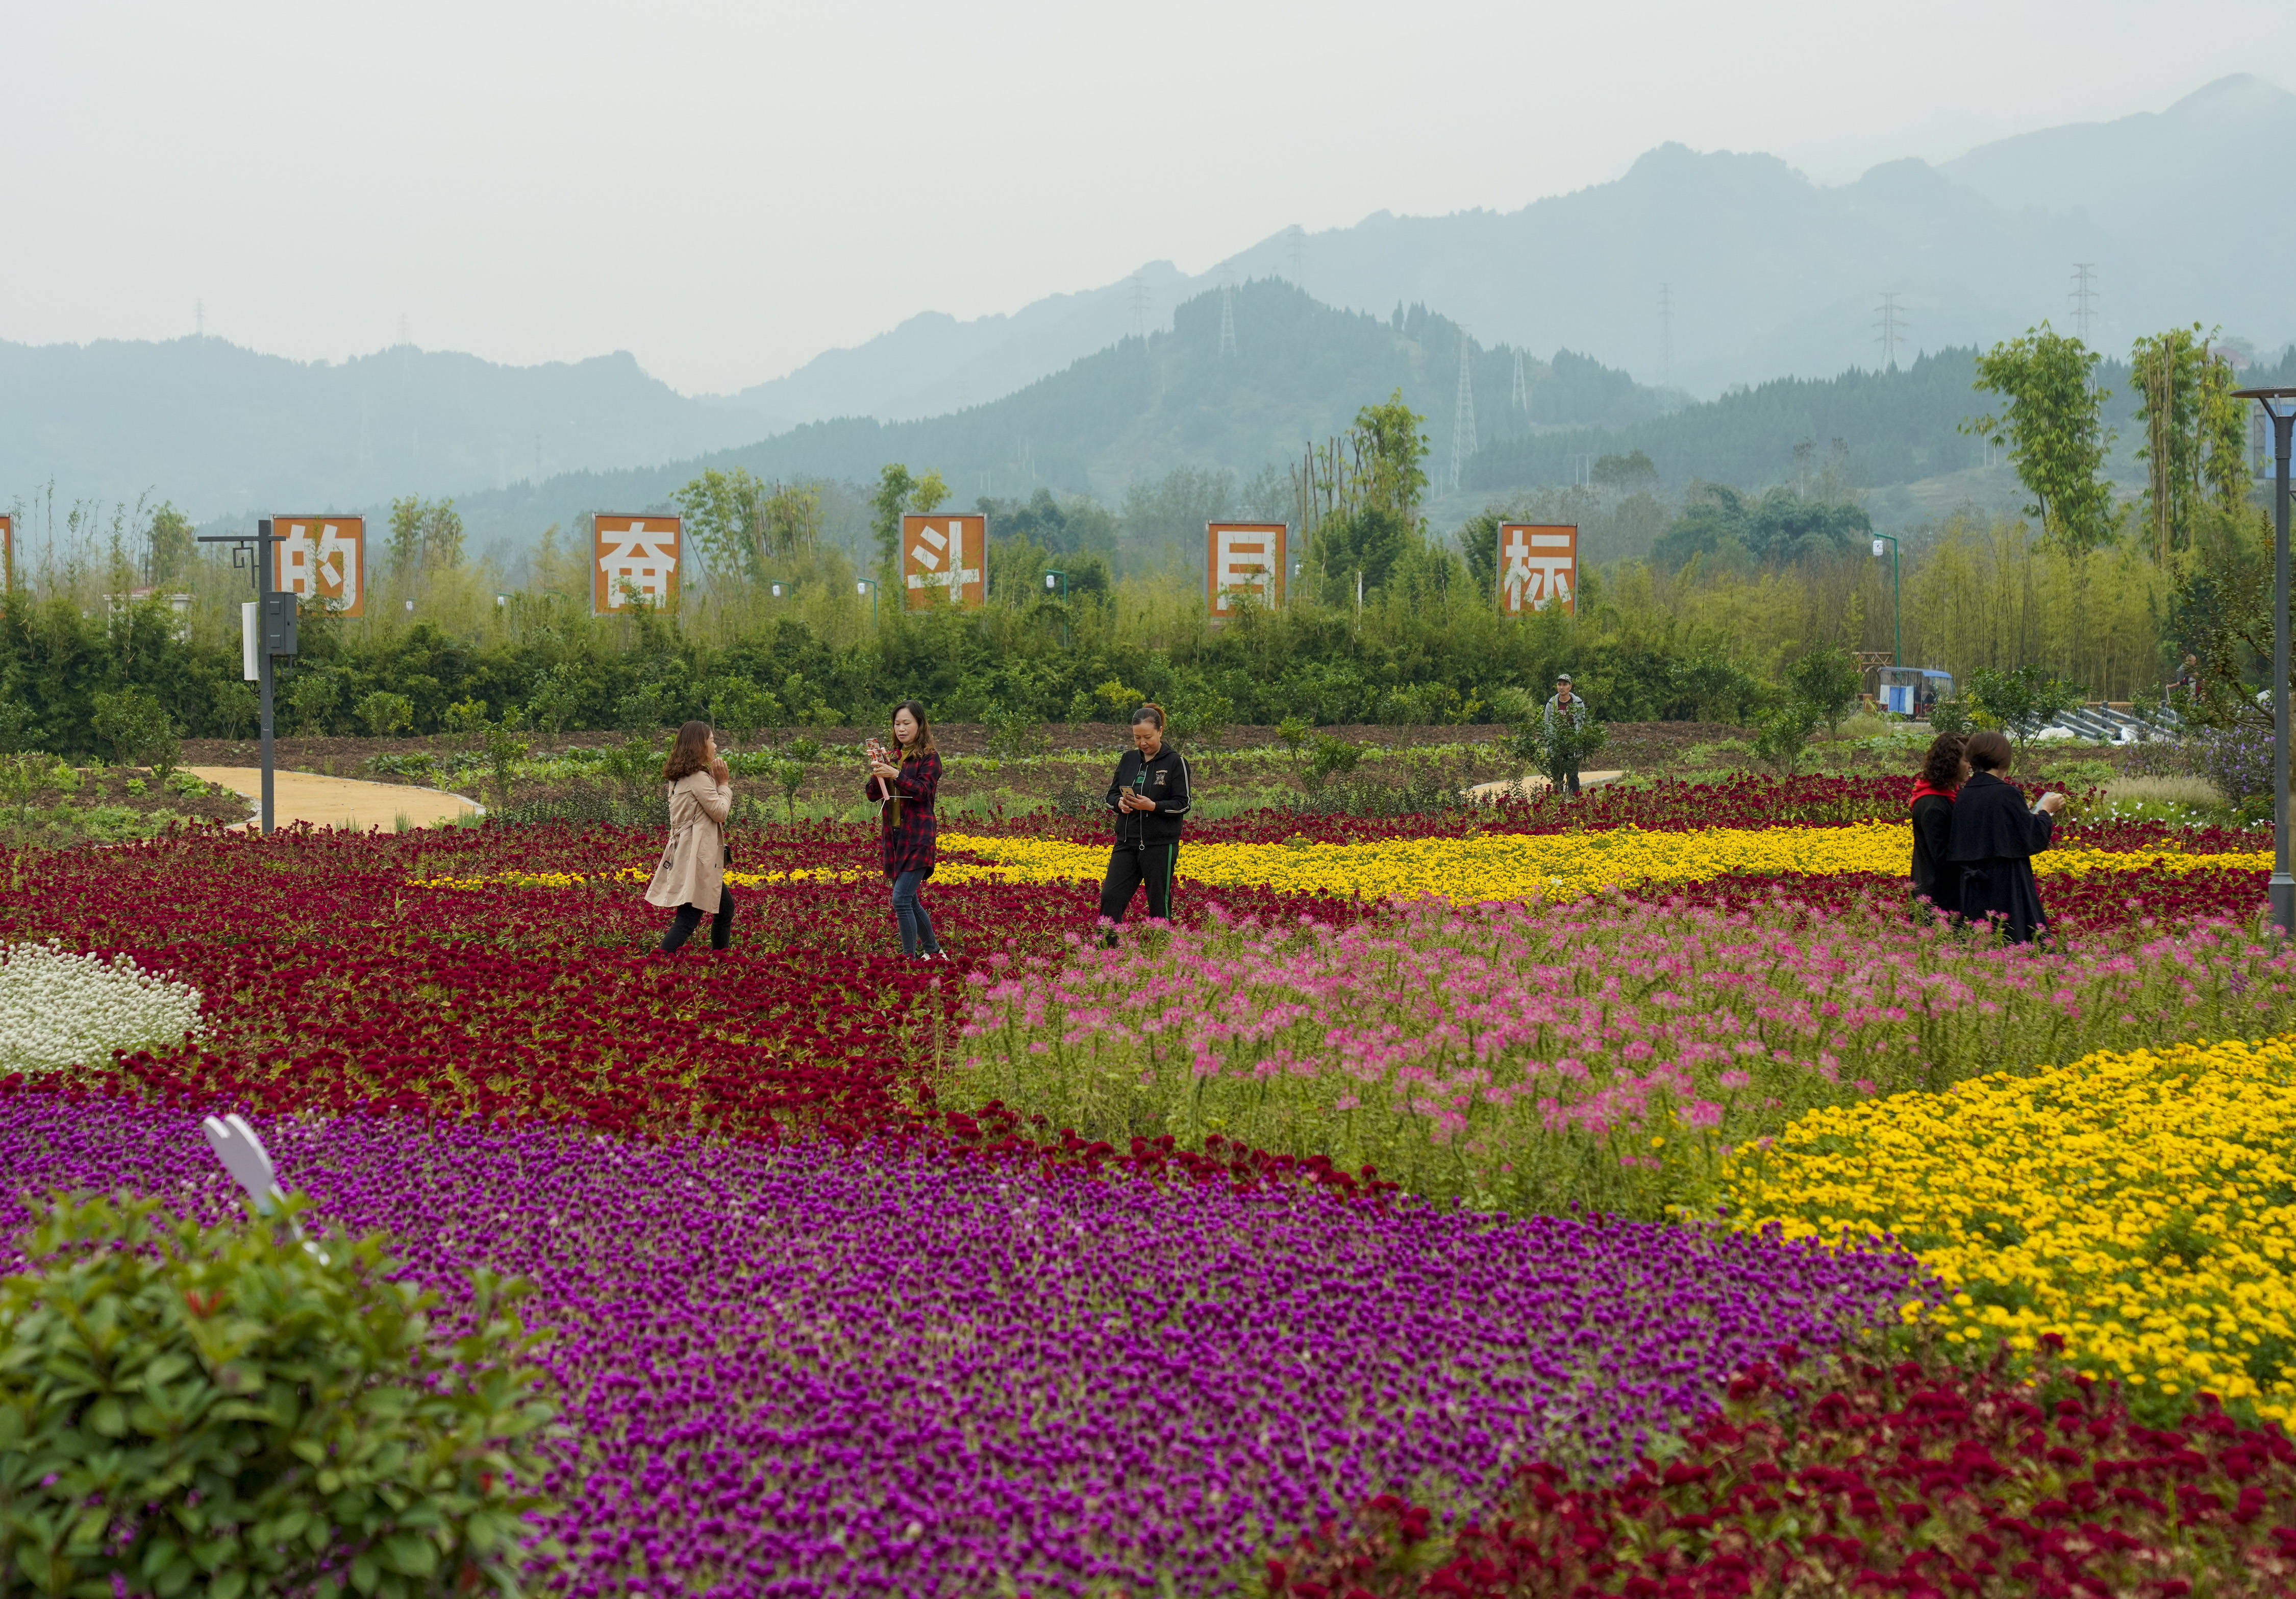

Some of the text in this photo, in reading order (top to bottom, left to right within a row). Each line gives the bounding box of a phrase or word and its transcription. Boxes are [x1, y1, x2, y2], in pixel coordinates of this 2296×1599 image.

[280, 524, 356, 611] 的
[599, 522, 676, 608] 奋
[907, 521, 980, 606] 斗
[1217, 531, 1276, 611] 目
[1504, 530, 1571, 611] 标
